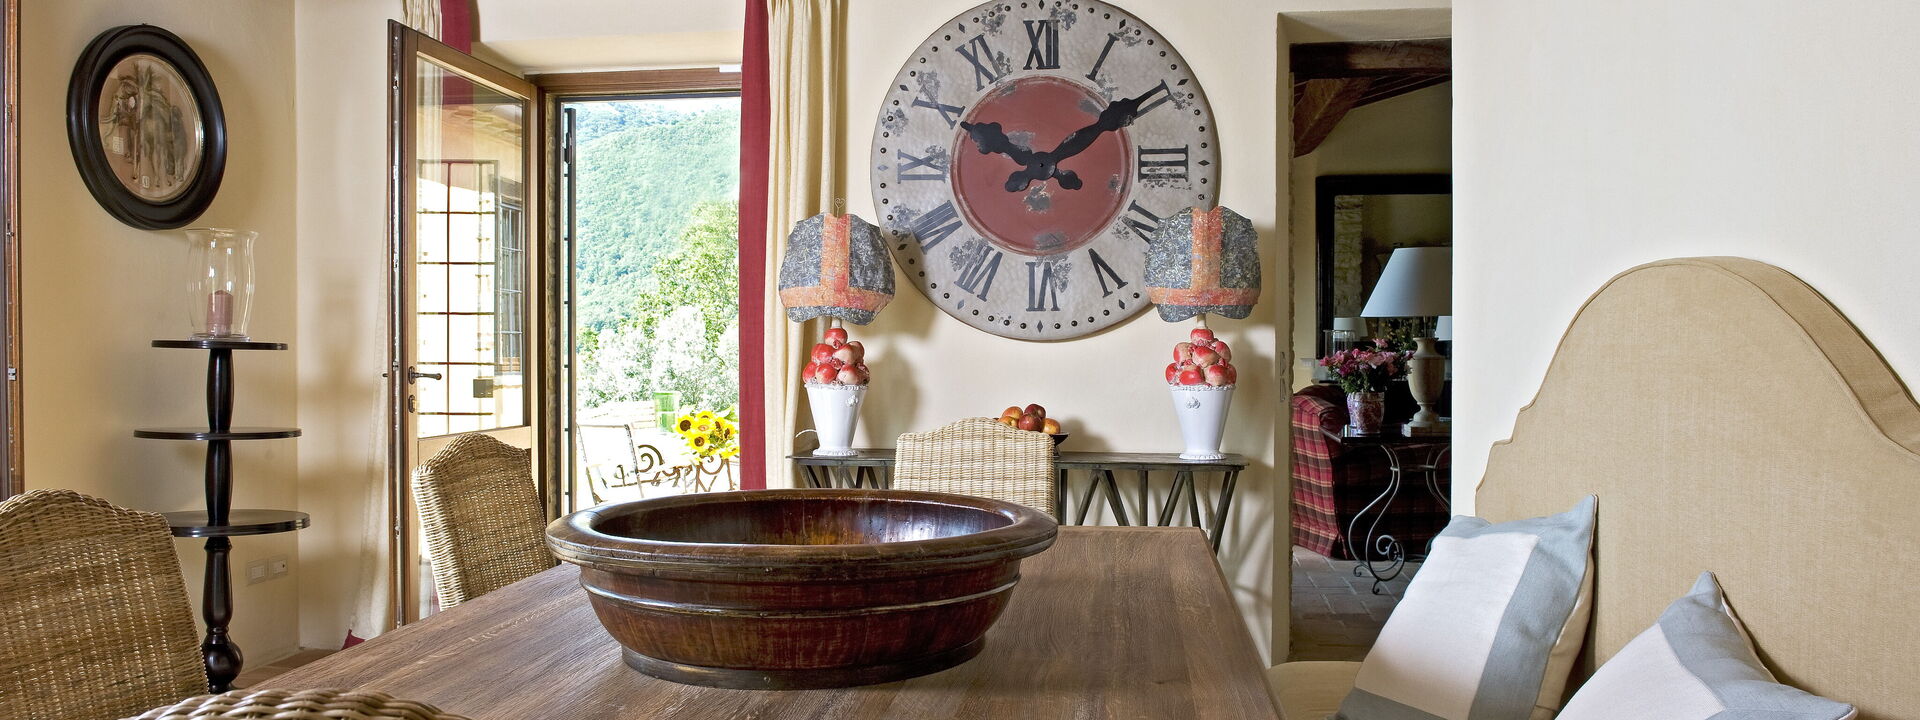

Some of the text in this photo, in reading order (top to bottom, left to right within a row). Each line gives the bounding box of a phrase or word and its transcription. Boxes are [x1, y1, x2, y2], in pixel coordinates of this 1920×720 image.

[955, 33, 1006, 92] XI
[1023, 19, 1061, 70] XII
[1085, 32, 1120, 81] I
[912, 83, 958, 130] X
[898, 149, 947, 184] IX
[1138, 144, 1189, 183] III
[910, 199, 964, 256] VIII
[954, 239, 1004, 302] VII
[1025, 261, 1061, 312] VI
[1088, 248, 1129, 298] V
